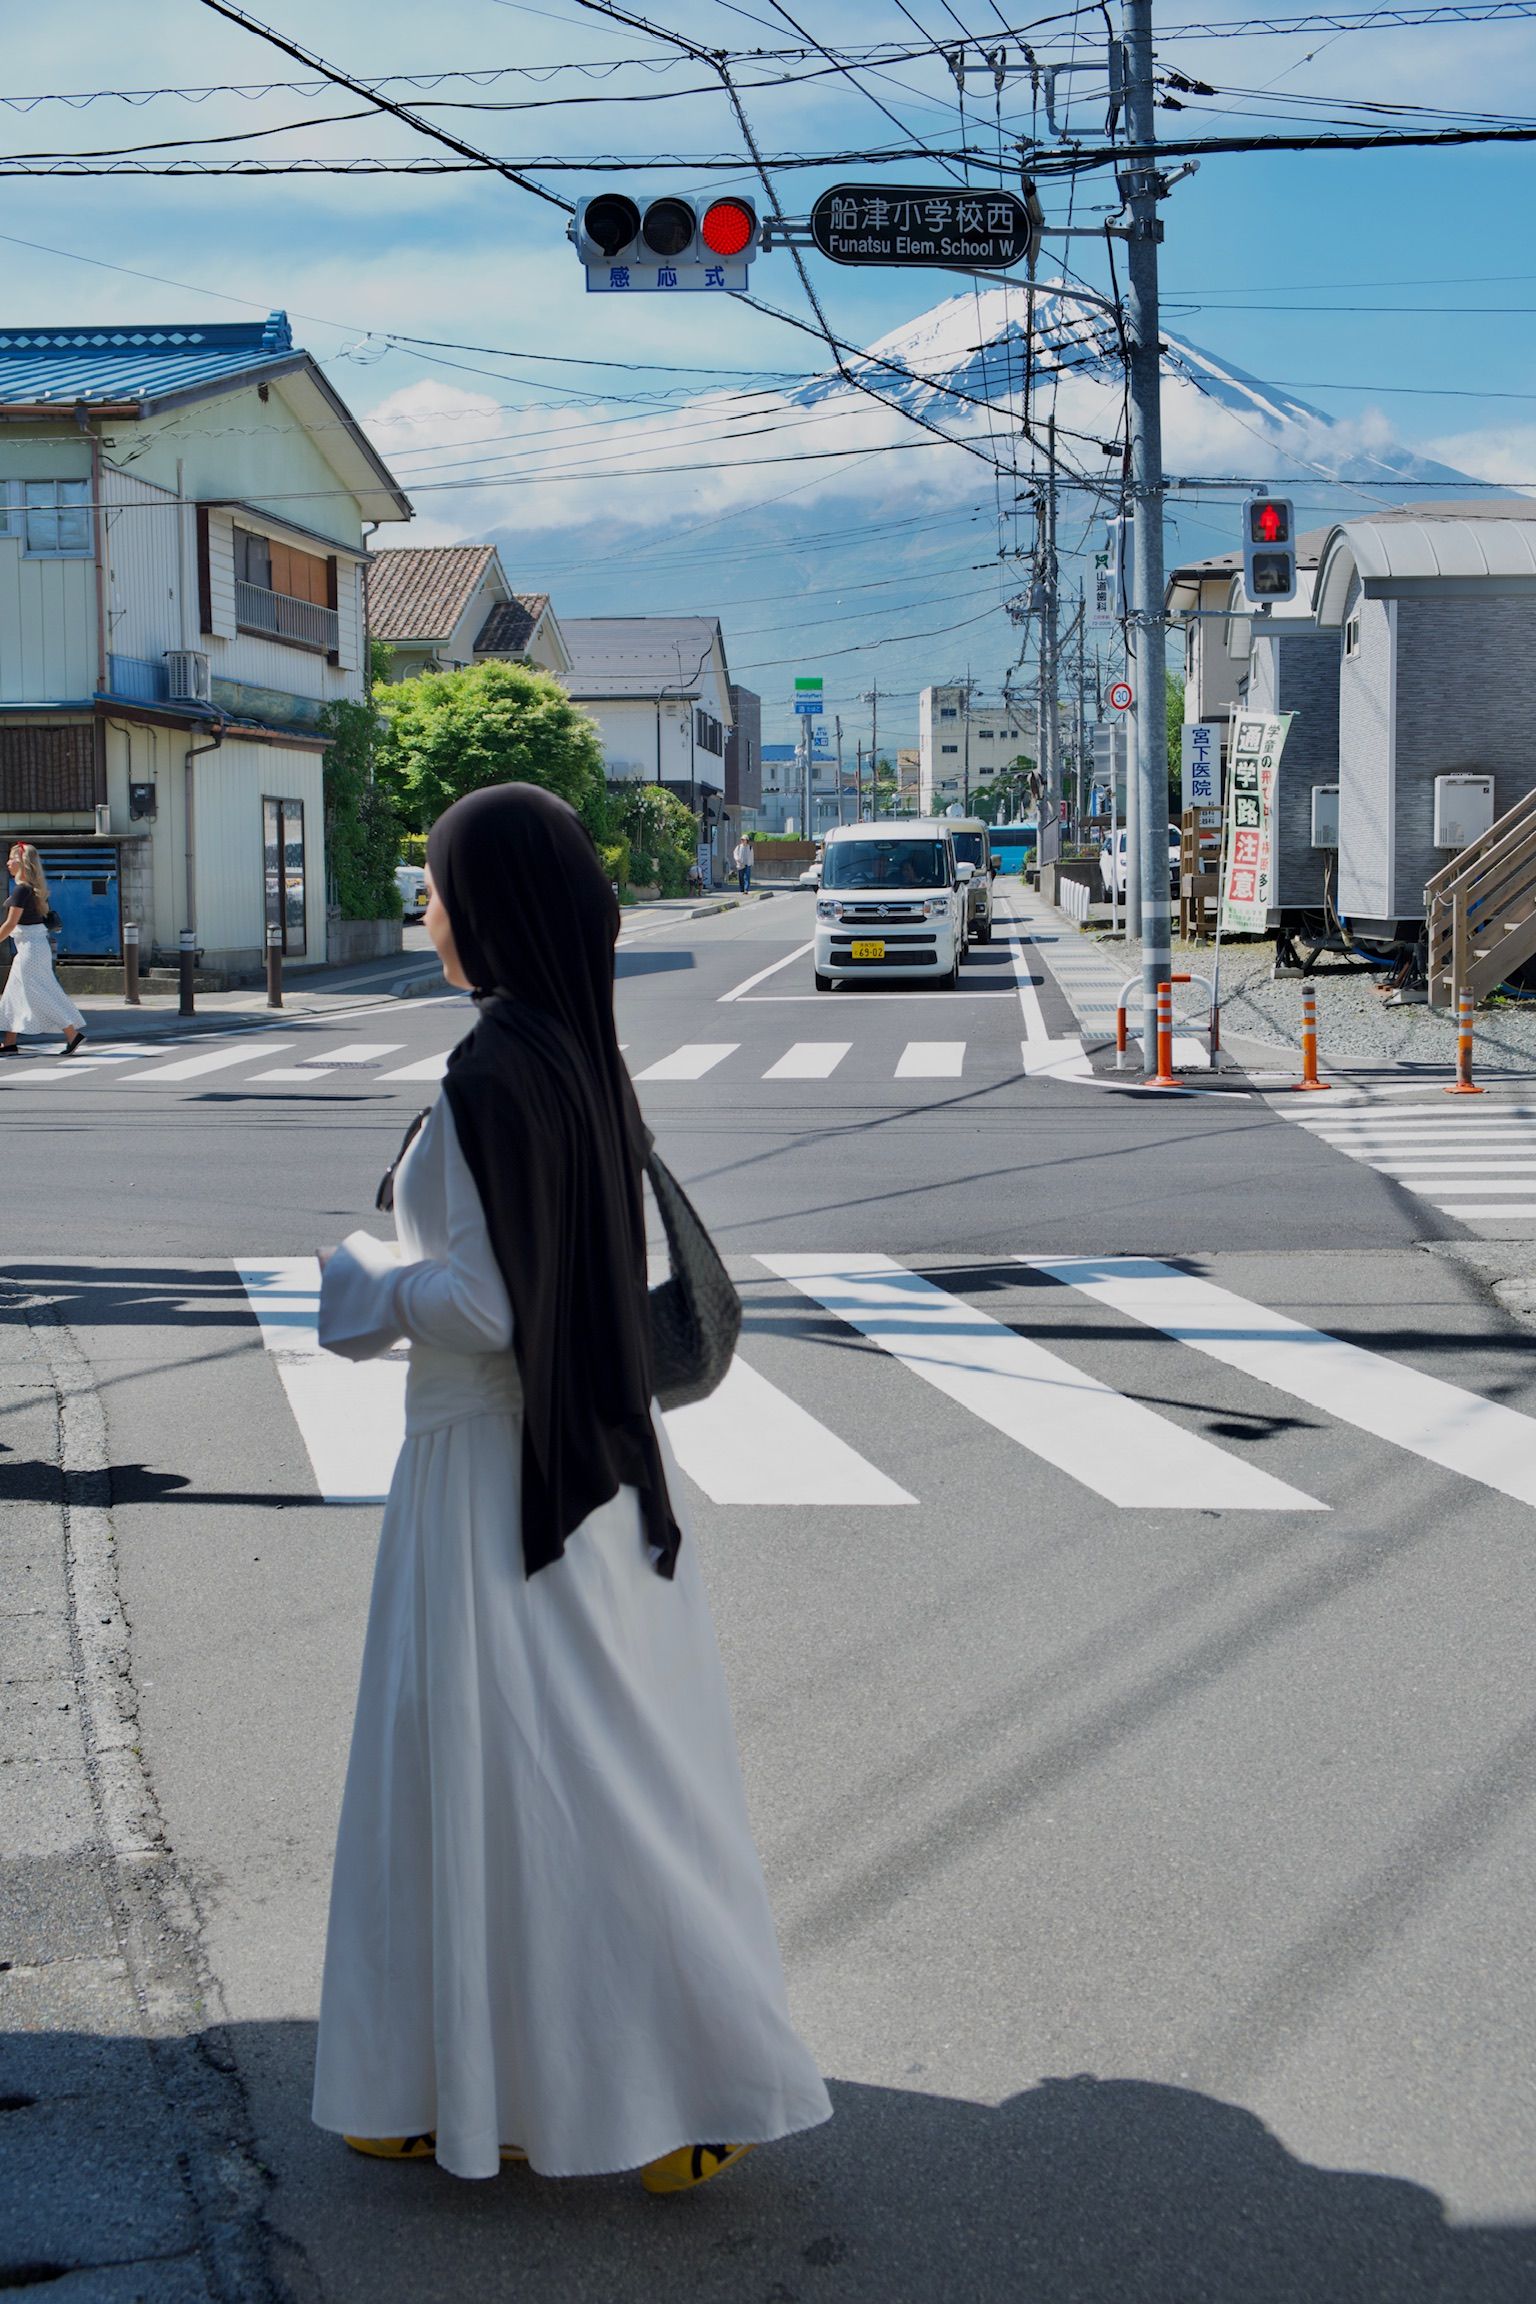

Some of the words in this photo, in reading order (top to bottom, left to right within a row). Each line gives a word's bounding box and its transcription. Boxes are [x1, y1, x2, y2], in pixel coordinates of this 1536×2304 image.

[829, 196, 1015, 234] 船津小学校西
[829, 235, 891, 254] Funatsu
[1096, 571, 1107, 612] 山道歯科
[1115, 690, 1128, 703] 30
[1191, 727, 1212, 797] 宮下医院
[1232, 723, 1263, 899] 通学路注意
[859, 947, 883, 957] 69-02
